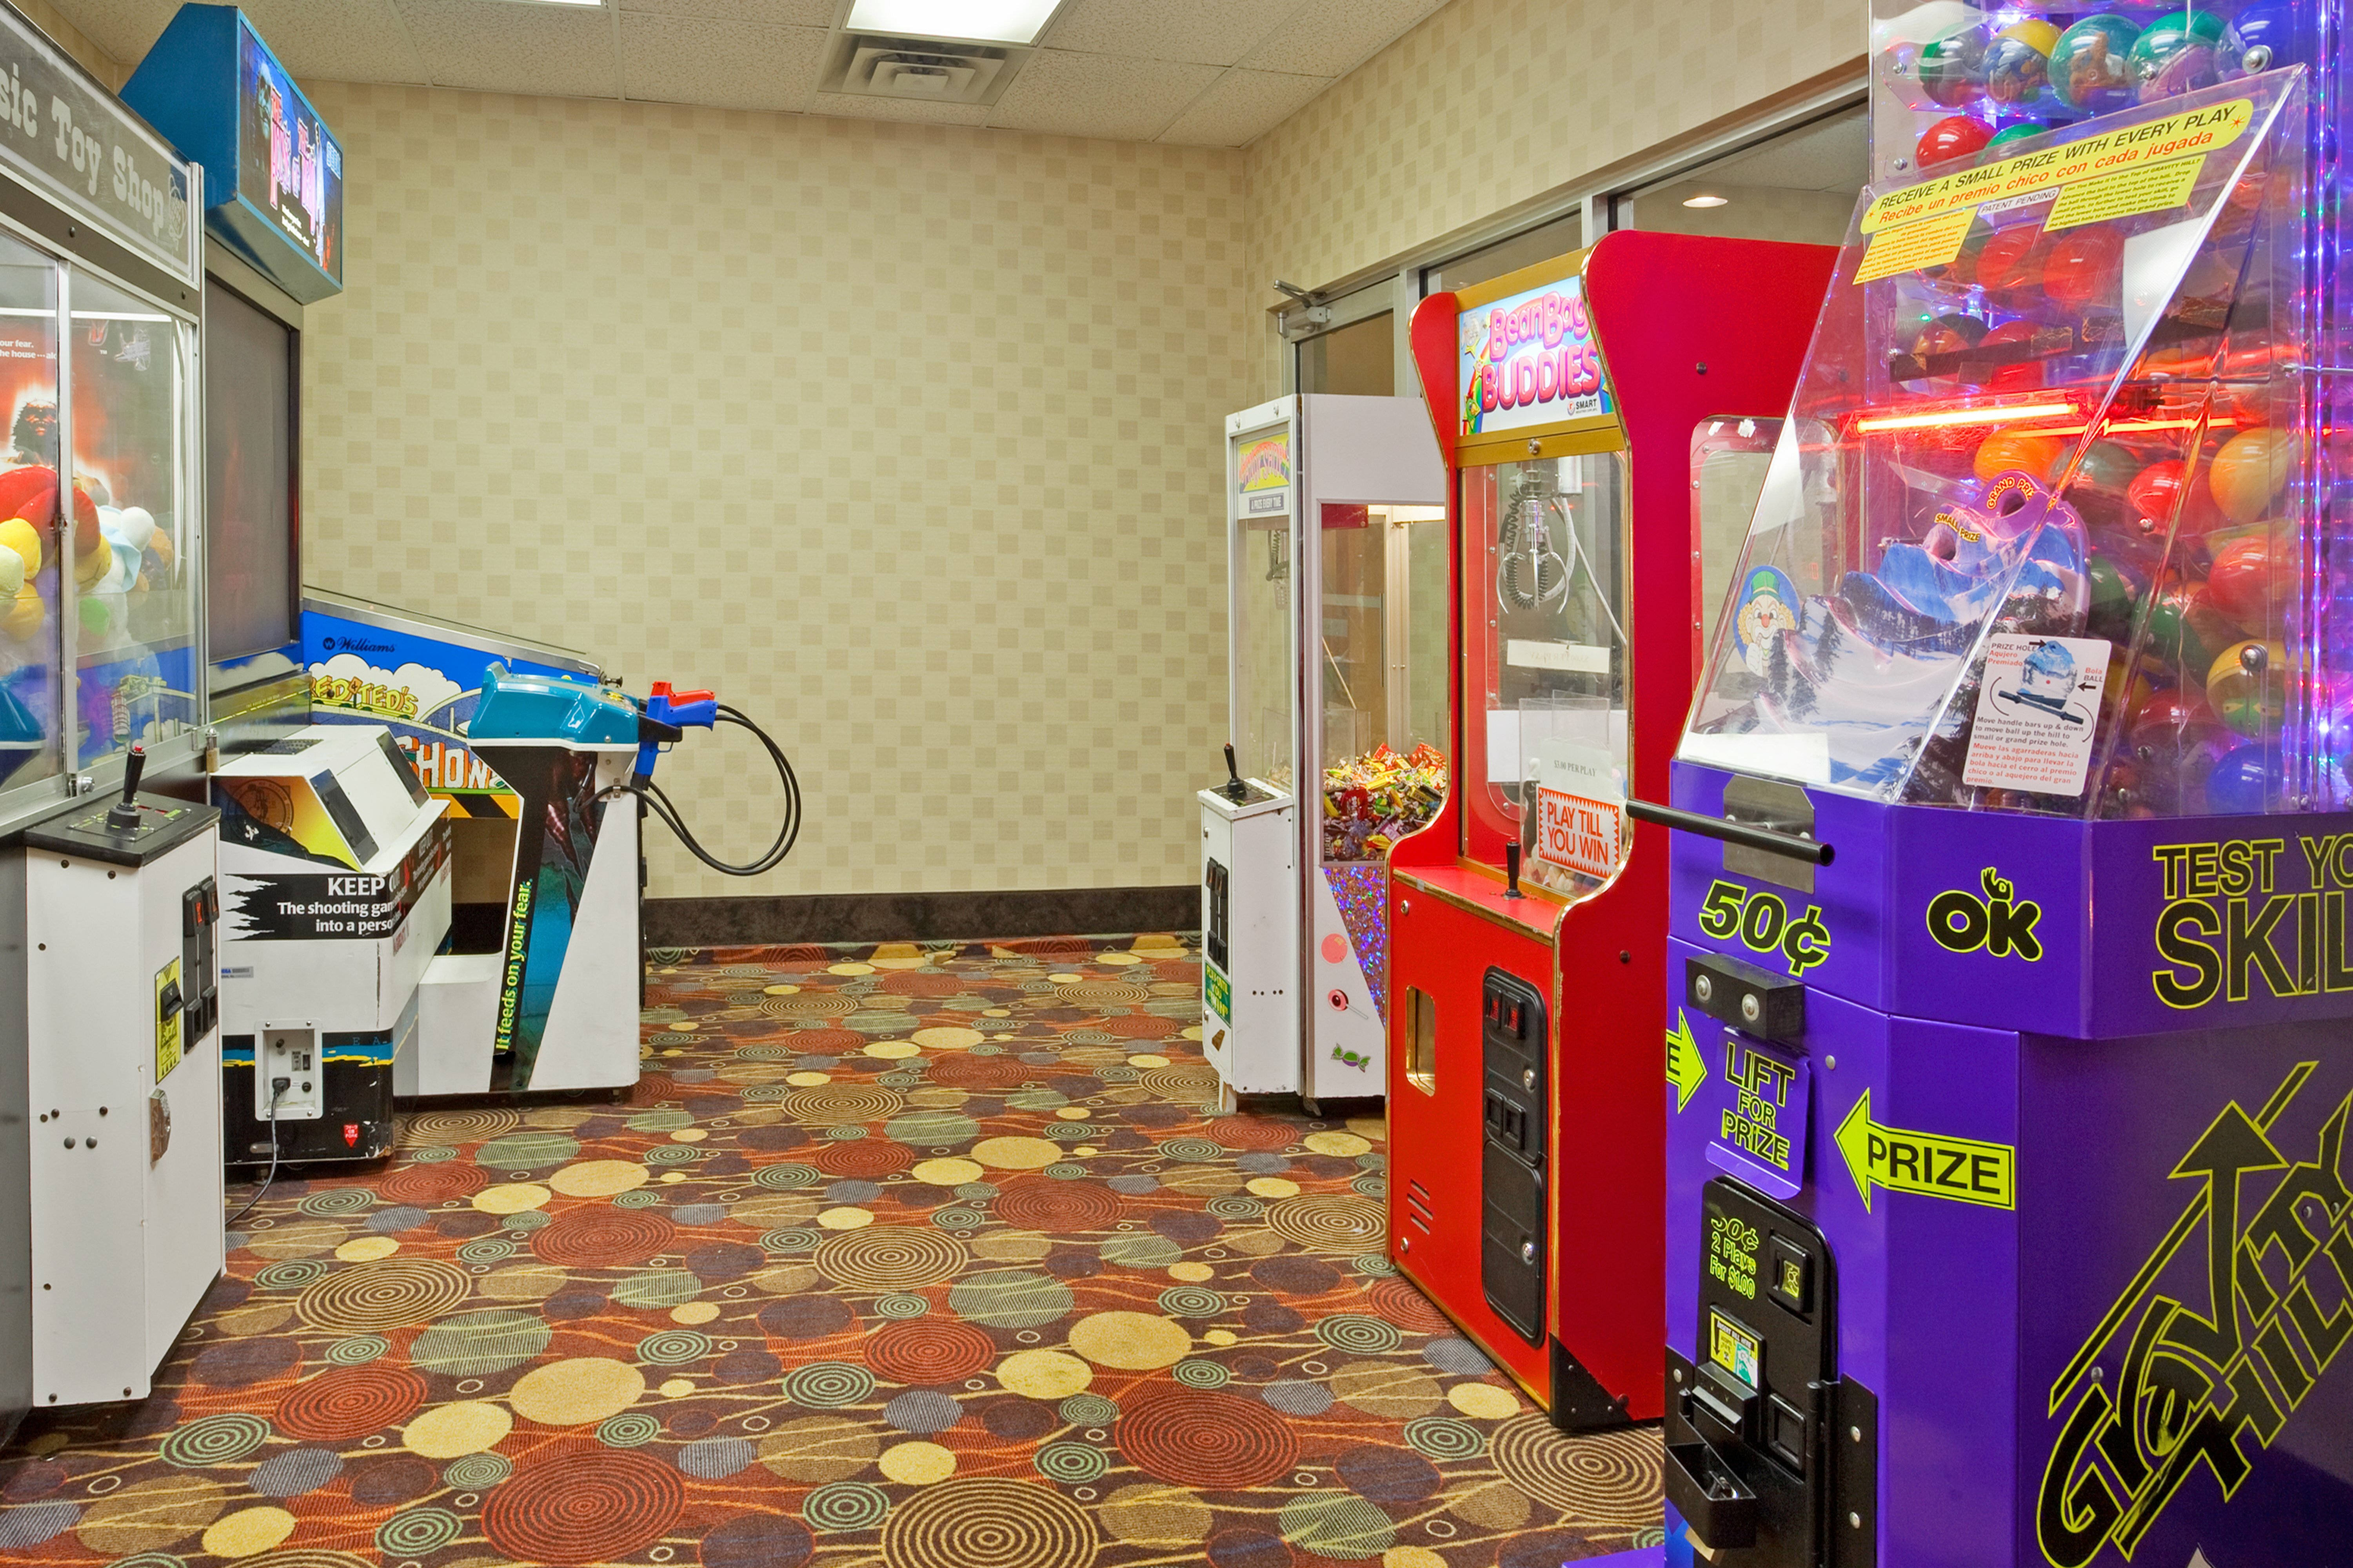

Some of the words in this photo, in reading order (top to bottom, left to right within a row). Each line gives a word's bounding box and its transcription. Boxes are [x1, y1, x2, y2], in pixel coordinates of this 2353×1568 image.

[51, 95, 102, 196] Toy
[113, 145, 164, 237] Shop
[1879, 183, 1937, 210] RECEIVE
[1939, 180, 1950, 192] A
[1955, 165, 2006, 188] SMALL
[2010, 151, 2059, 173] PRIZE
[2066, 137, 2110, 160] WITH
[2114, 120, 2180, 147] EVERY
[2184, 105, 2237, 130] PLAY
[2150, 162, 2180, 173] GRAVITY
[1879, 202, 1923, 224] Recibe
[1928, 196, 1945, 210] un
[1949, 183, 2000, 207] premio
[2007, 171, 2049, 191] chico
[2057, 162, 2087, 178] con
[2095, 149, 2138, 169] cada
[2144, 131, 2213, 159] jugada
[1981, 200, 2012, 213] PATENT
[2015, 190, 2057, 206] PENDING
[15, 340, 34, 348] fear.
[1482, 340, 1601, 413] BUDDIES
[1575, 399, 1597, 410] SMART
[1987, 476, 2015, 509] GRAND
[2017, 478, 2035, 501] PRIZ
[1934, 513, 1959, 532] SMALL
[1958, 528, 1981, 543] PRIZE
[337, 636, 395, 653] Williams
[1988, 658, 2023, 666] Premiado
[358, 682, 418, 715] TED'S
[1977, 716, 1996, 724] Move
[1998, 718, 2022, 726] handle
[2064, 724, 2084, 732] down
[1973, 742, 1997, 751] Mueve
[2011, 747, 2056, 757] agarraderas
[2058, 750, 2079, 759] hacia
[2005, 735, 2028, 744] grand
[2029, 737, 2048, 746] prize
[2050, 739, 2068, 748] hole.
[1554, 759, 1567, 771] $3.00
[1568, 763, 1579, 773] PER
[1580, 765, 1597, 777] PLAY
[1987, 761, 2008, 769] hacia
[2050, 768, 2077, 777] premio
[2002, 754, 2023, 763] abajo
[2024, 757, 2041, 765] para
[2043, 758, 2065, 766] llevar
[1966, 776, 1994, 785] premio.
[2005, 771, 2038, 781] aquejero
[2053, 776, 2071, 784] gran
[1547, 802, 1575, 829] PLAY
[1578, 809, 1603, 838] TILL
[1547, 826, 1576, 856] YOU
[1579, 835, 1608, 865] WIN
[2153, 838, 2284, 900] TEST
[327, 877, 385, 896] KEEP
[513, 878, 533, 918] fear.
[278, 902, 305, 914] The
[308, 901, 368, 917] shooting
[316, 919, 343, 931] into
[346, 922, 355, 931] a
[1698, 879, 1831, 978] 50¢
[1926, 889, 2043, 962] OK
[509, 923, 527, 963] your
[506, 965, 521, 988] on
[1212, 984, 1222, 999] YOU
[497, 989, 516, 1035] feeds
[496, 1034, 509, 1050] It
[1725, 1041, 1795, 1107] LIFT
[1737, 1089, 1777, 1130] FOR
[1721, 1108, 1790, 1171] PRIZE
[1867, 1132, 2001, 1195] PRIZE
[1711, 1231, 1721, 1254] 2
[1723, 1237, 1757, 1275] Plays
[1710, 1254, 1727, 1282] For
[1728, 1265, 1755, 1300] $1.00
[1717, 1320, 1731, 1336] INSERT
[1741, 1335, 1752, 1349] HERE
